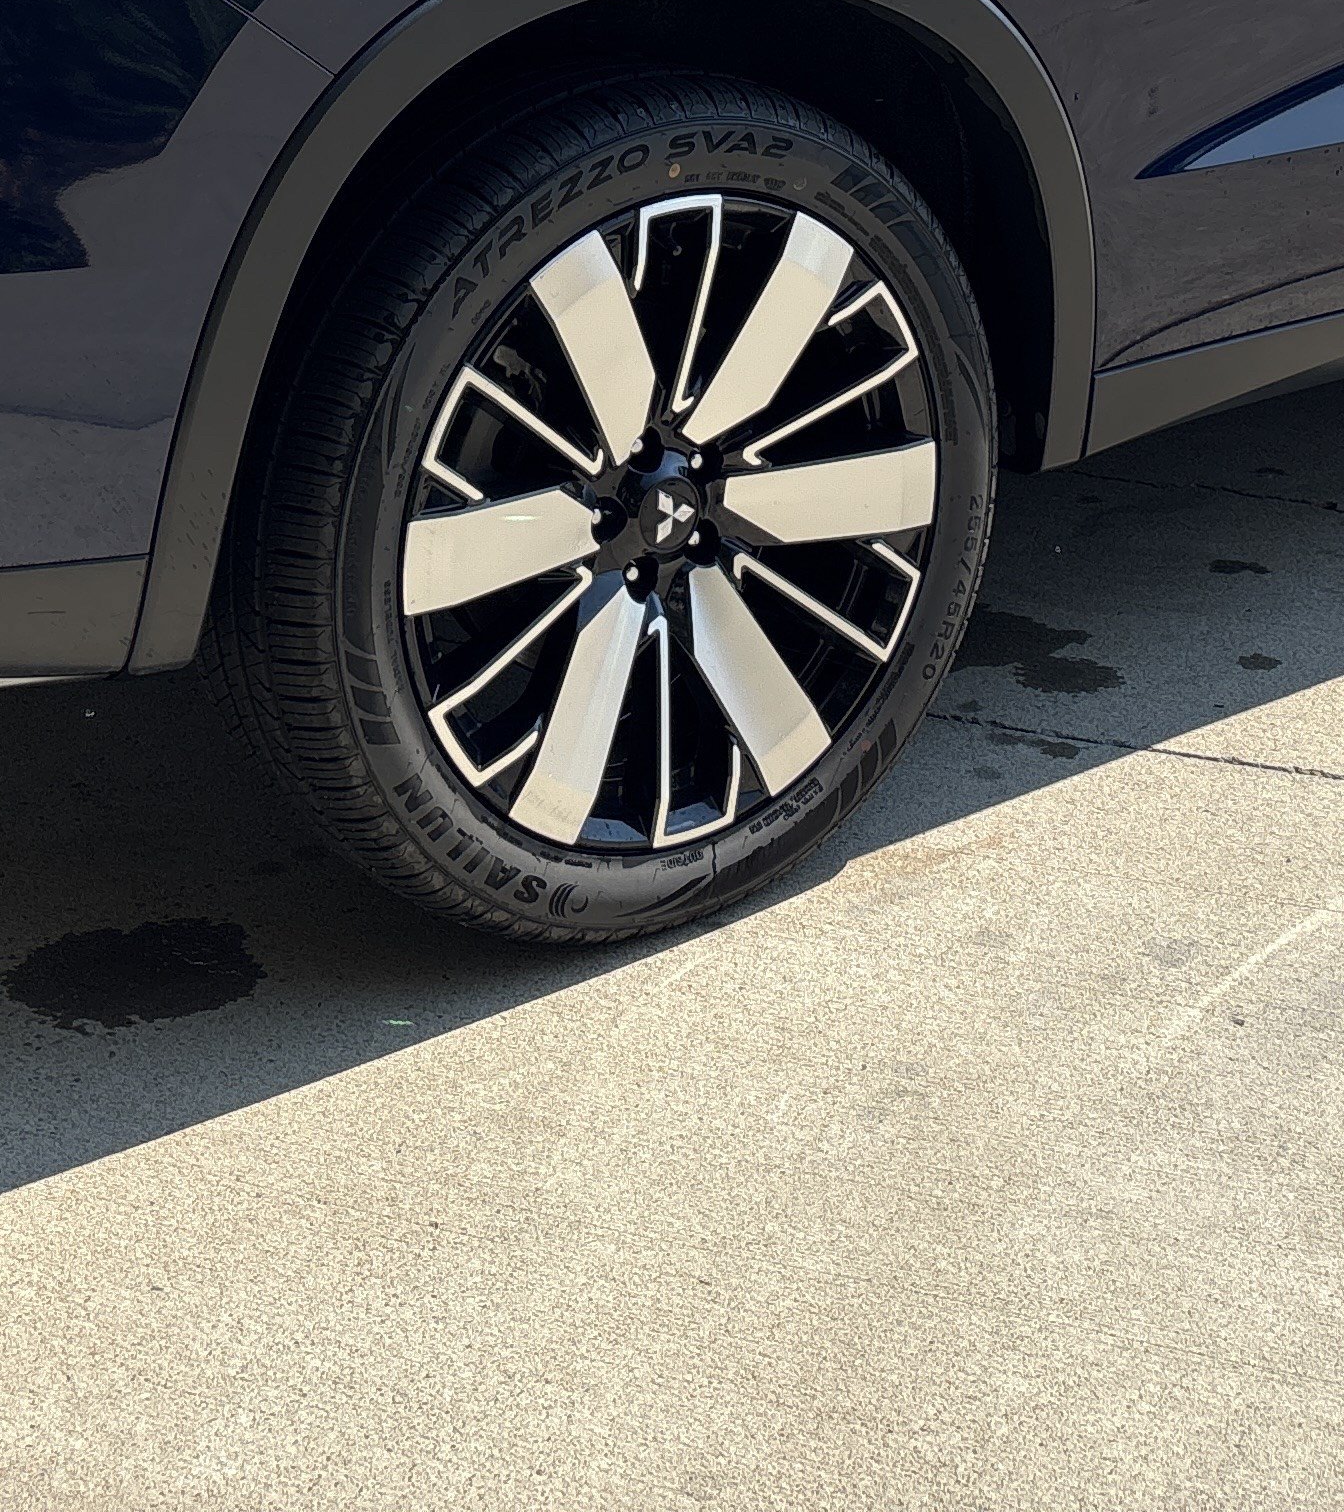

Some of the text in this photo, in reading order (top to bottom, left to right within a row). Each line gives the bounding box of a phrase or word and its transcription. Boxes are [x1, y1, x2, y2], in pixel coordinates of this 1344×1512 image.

[452, 130, 795, 320] ATREZZO SVA2
[921, 494, 984, 681] 255/45R20
[394, 770, 548, 904] SAILUN
